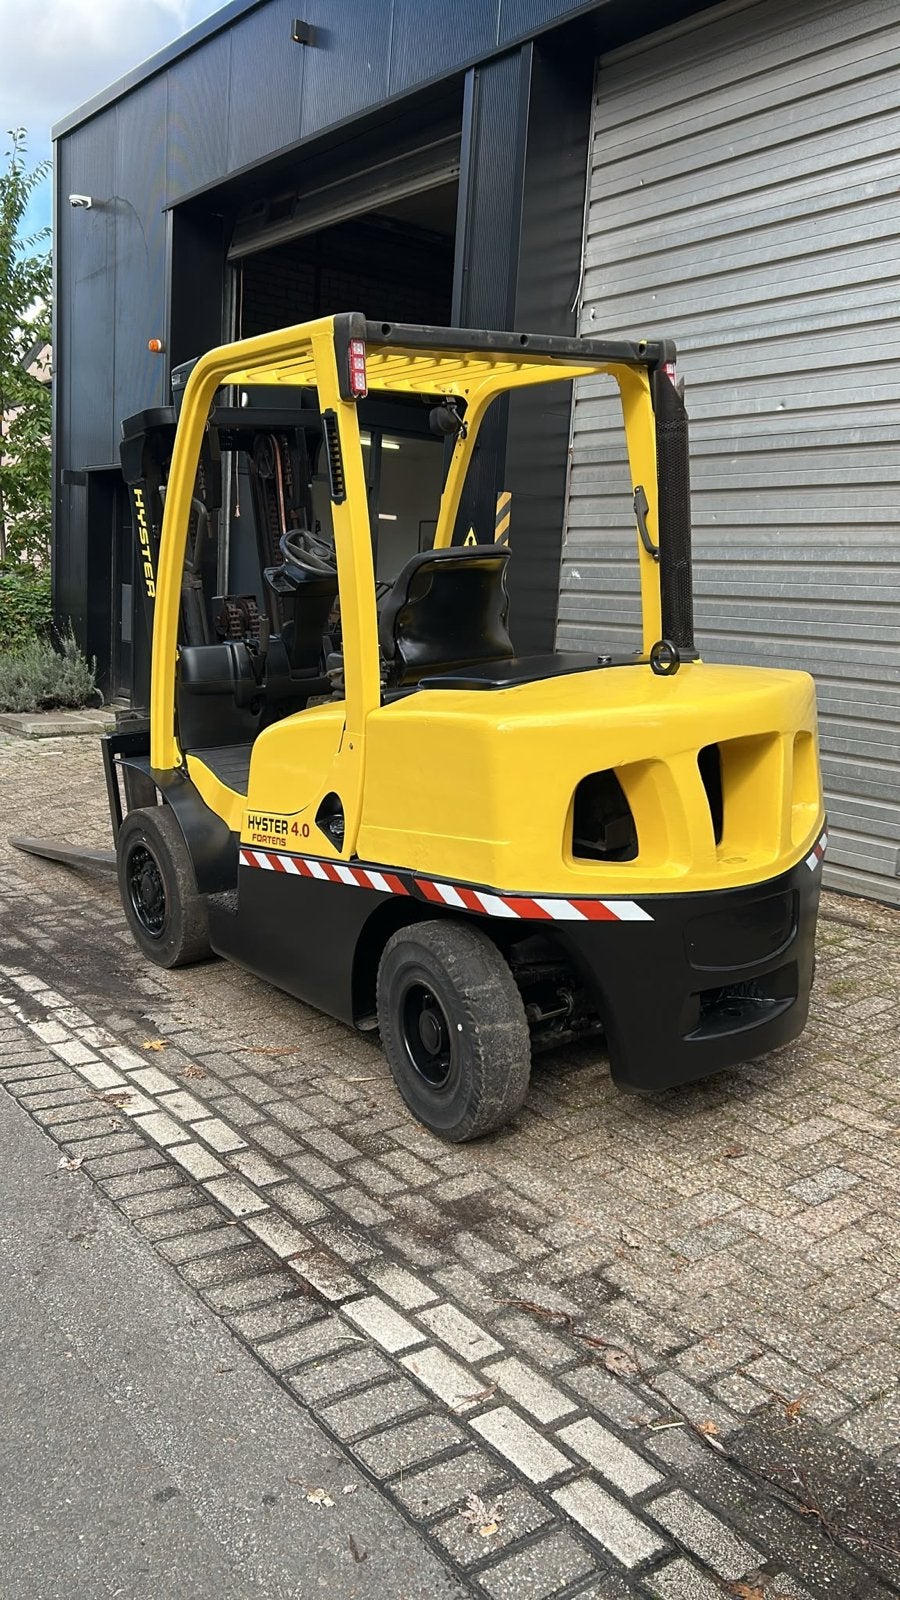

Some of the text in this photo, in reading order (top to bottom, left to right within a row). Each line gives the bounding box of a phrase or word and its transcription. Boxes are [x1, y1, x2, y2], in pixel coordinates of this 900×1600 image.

[133, 488, 156, 598] HYSTER
[248, 815, 310, 837] HYSTER 4.0
[252, 833, 286, 846] FORTENS
